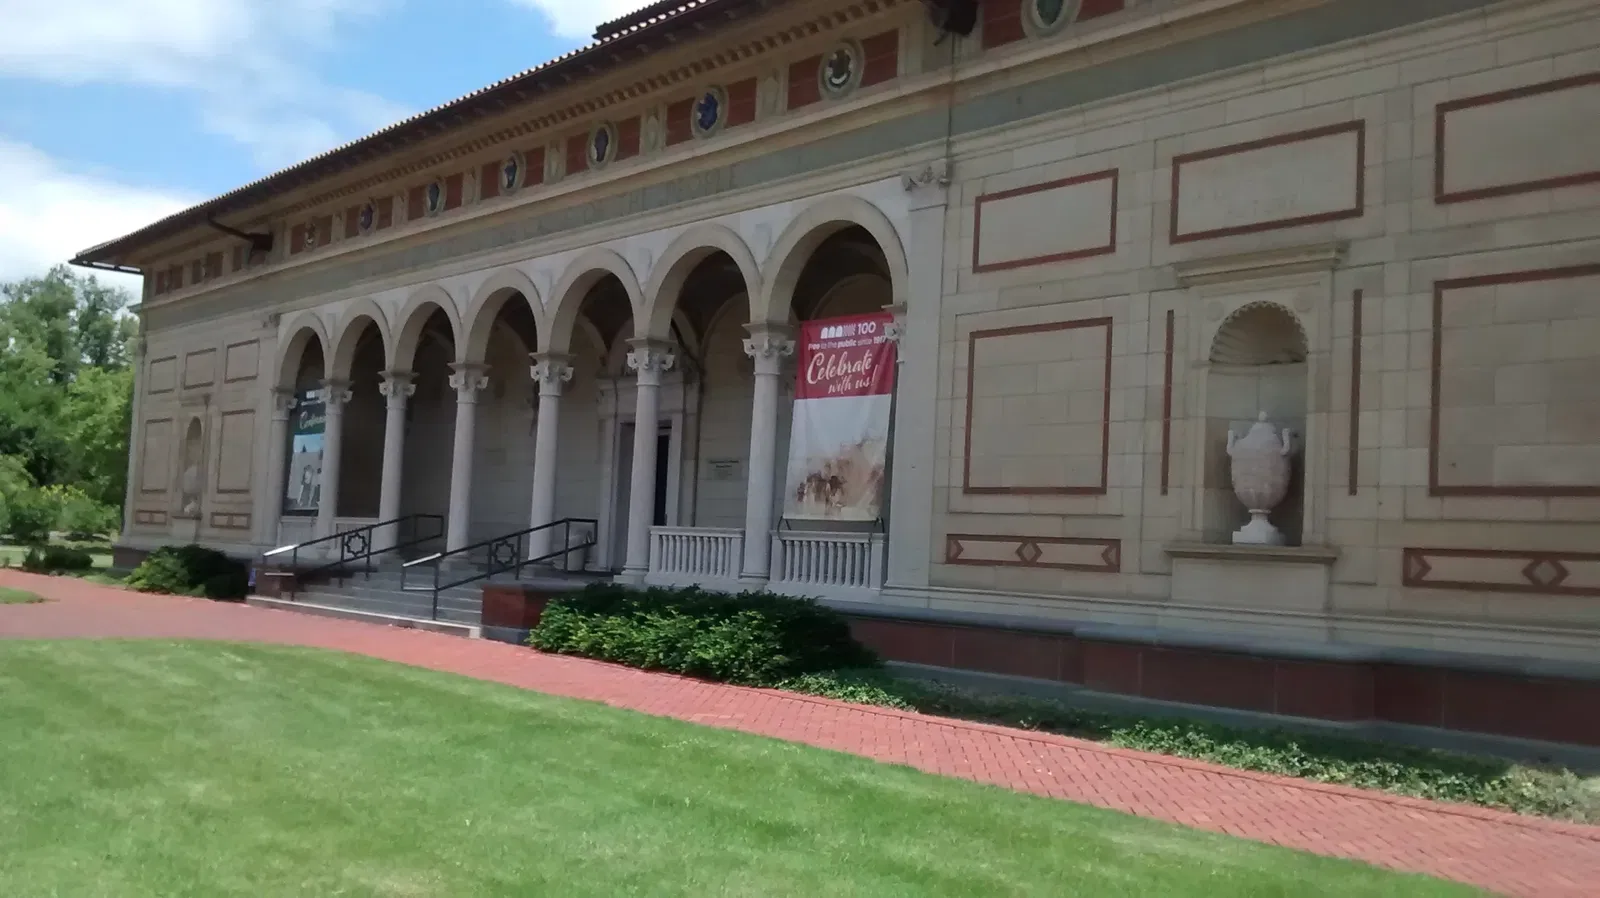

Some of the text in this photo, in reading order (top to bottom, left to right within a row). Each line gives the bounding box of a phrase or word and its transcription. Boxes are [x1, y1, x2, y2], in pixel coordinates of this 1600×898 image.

[858, 321, 877, 335] 100
[837, 339, 857, 348] public
[807, 349, 873, 384] Celebrate
[828, 364, 878, 395] with us!
